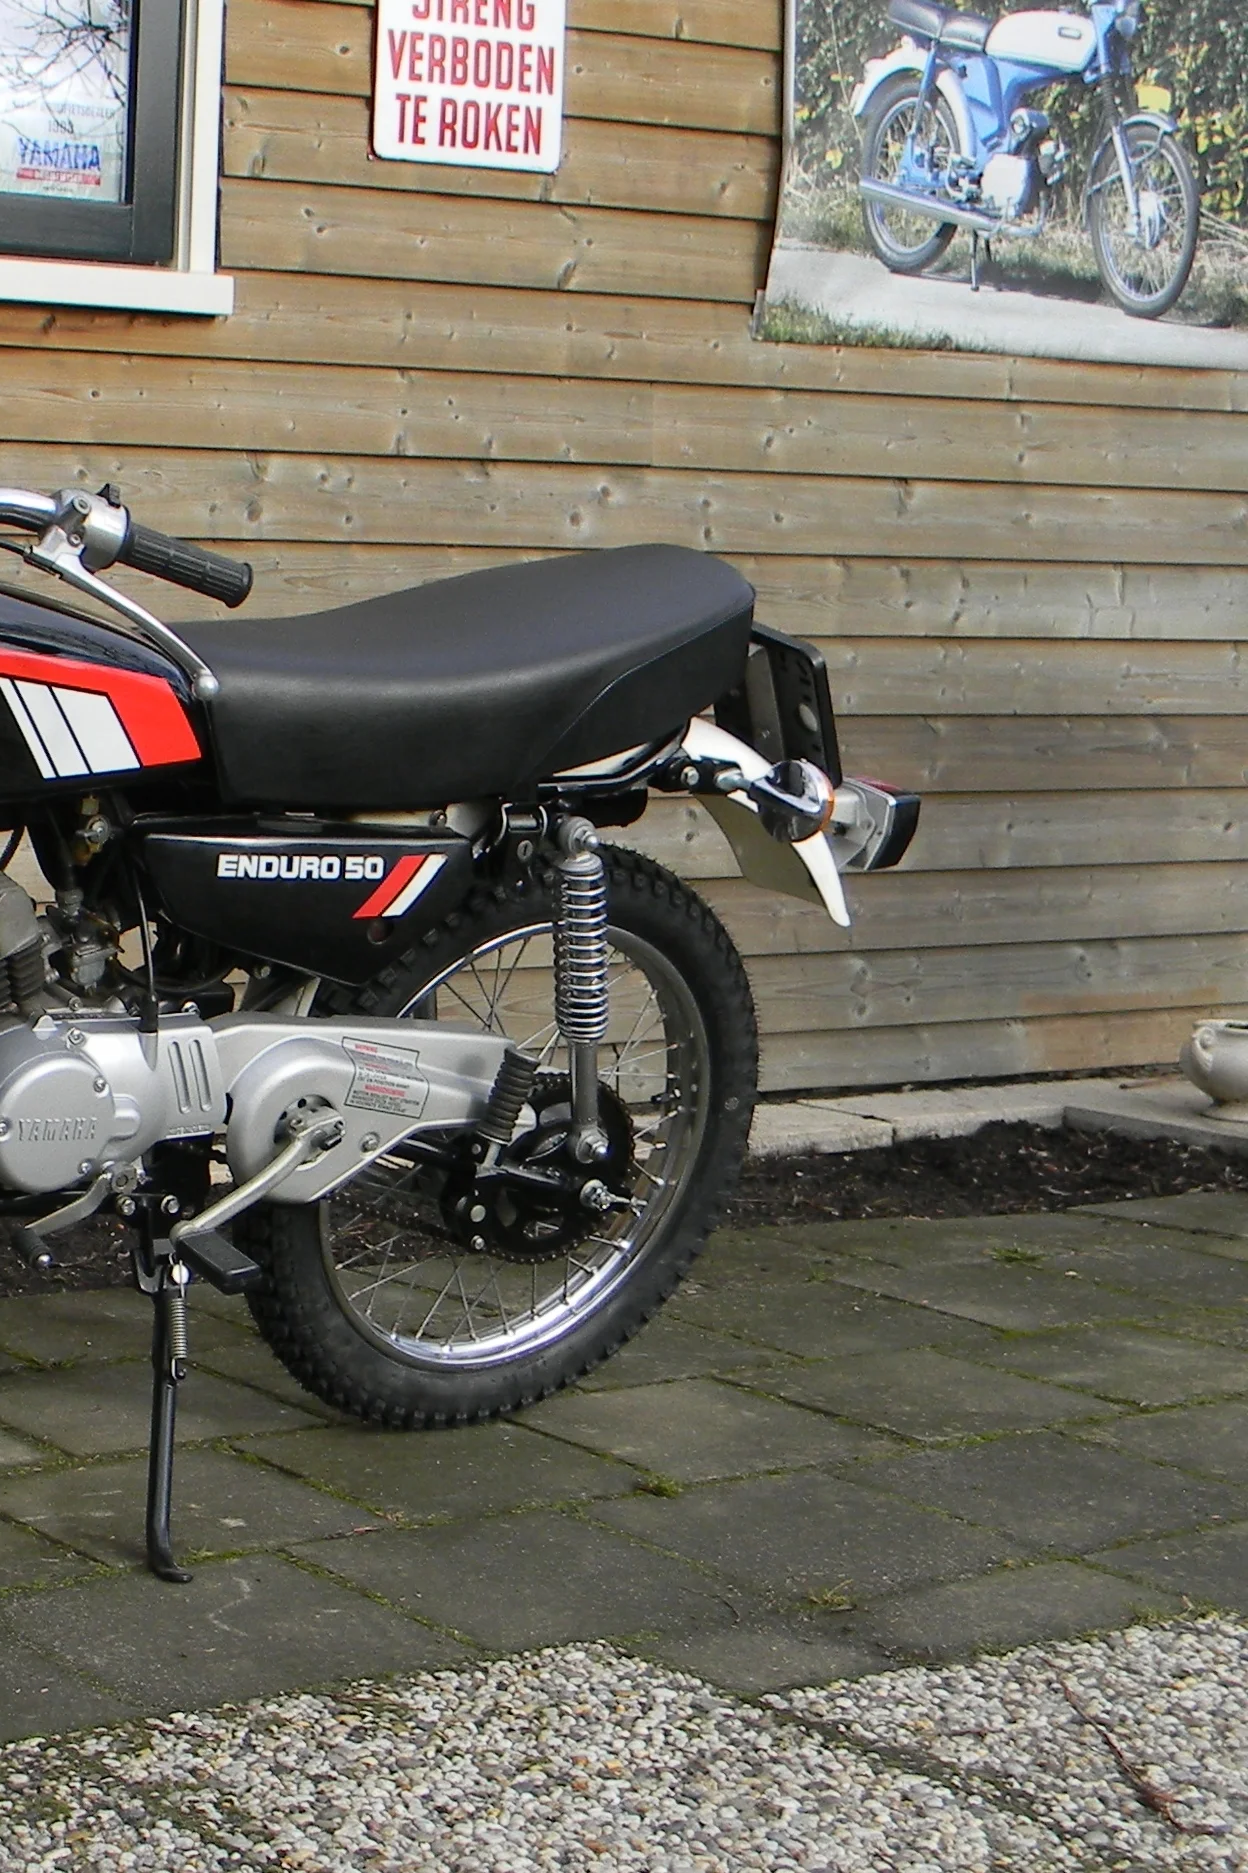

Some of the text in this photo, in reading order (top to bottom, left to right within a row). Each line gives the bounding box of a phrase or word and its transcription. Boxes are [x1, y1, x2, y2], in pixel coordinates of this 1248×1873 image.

[388, 28, 555, 96] VERBODEN
[395, 93, 543, 155] TE ROKEN
[217, 854, 385, 880] ENDURO 50
[18, 1117, 98, 1141] YAMAHA
